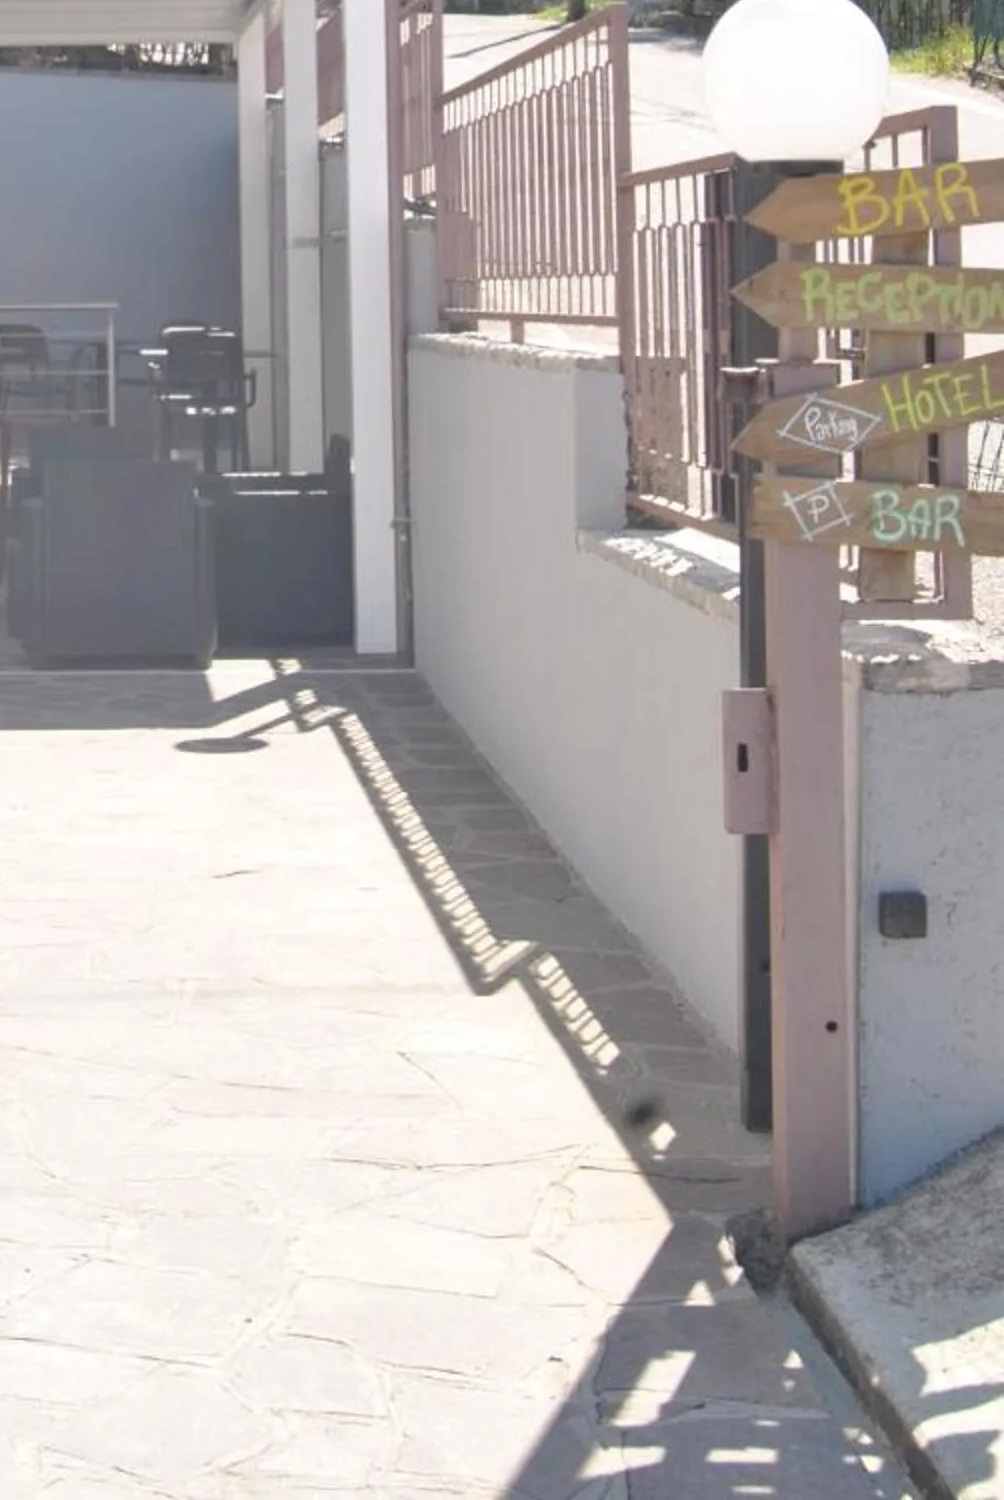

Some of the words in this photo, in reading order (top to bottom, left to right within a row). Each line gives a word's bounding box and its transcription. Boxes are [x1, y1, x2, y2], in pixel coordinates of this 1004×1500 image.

[836, 162, 979, 237] BAR
[881, 363, 1004, 432] HOTEL
[808, 495, 830, 525] P
[872, 488, 966, 548] BAR
